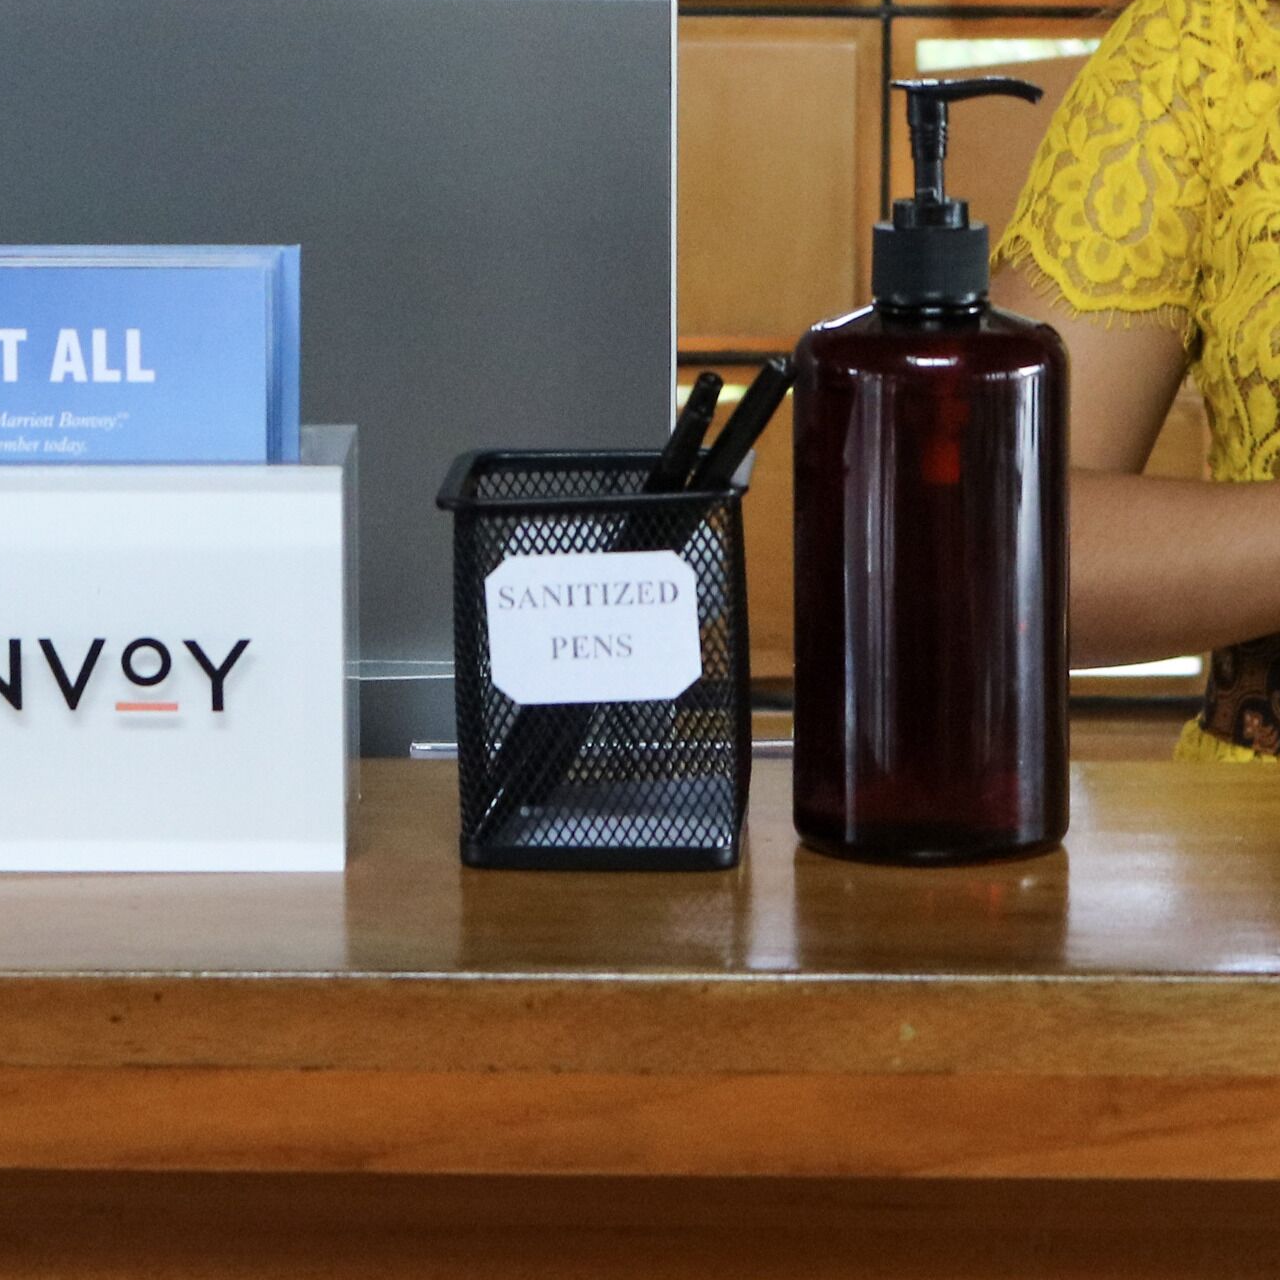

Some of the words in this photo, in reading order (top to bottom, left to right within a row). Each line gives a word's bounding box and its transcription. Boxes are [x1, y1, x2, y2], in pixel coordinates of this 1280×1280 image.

[49, 328, 156, 382] ALL
[498, 581, 680, 610] SANITIZED
[551, 634, 633, 660] PENS
